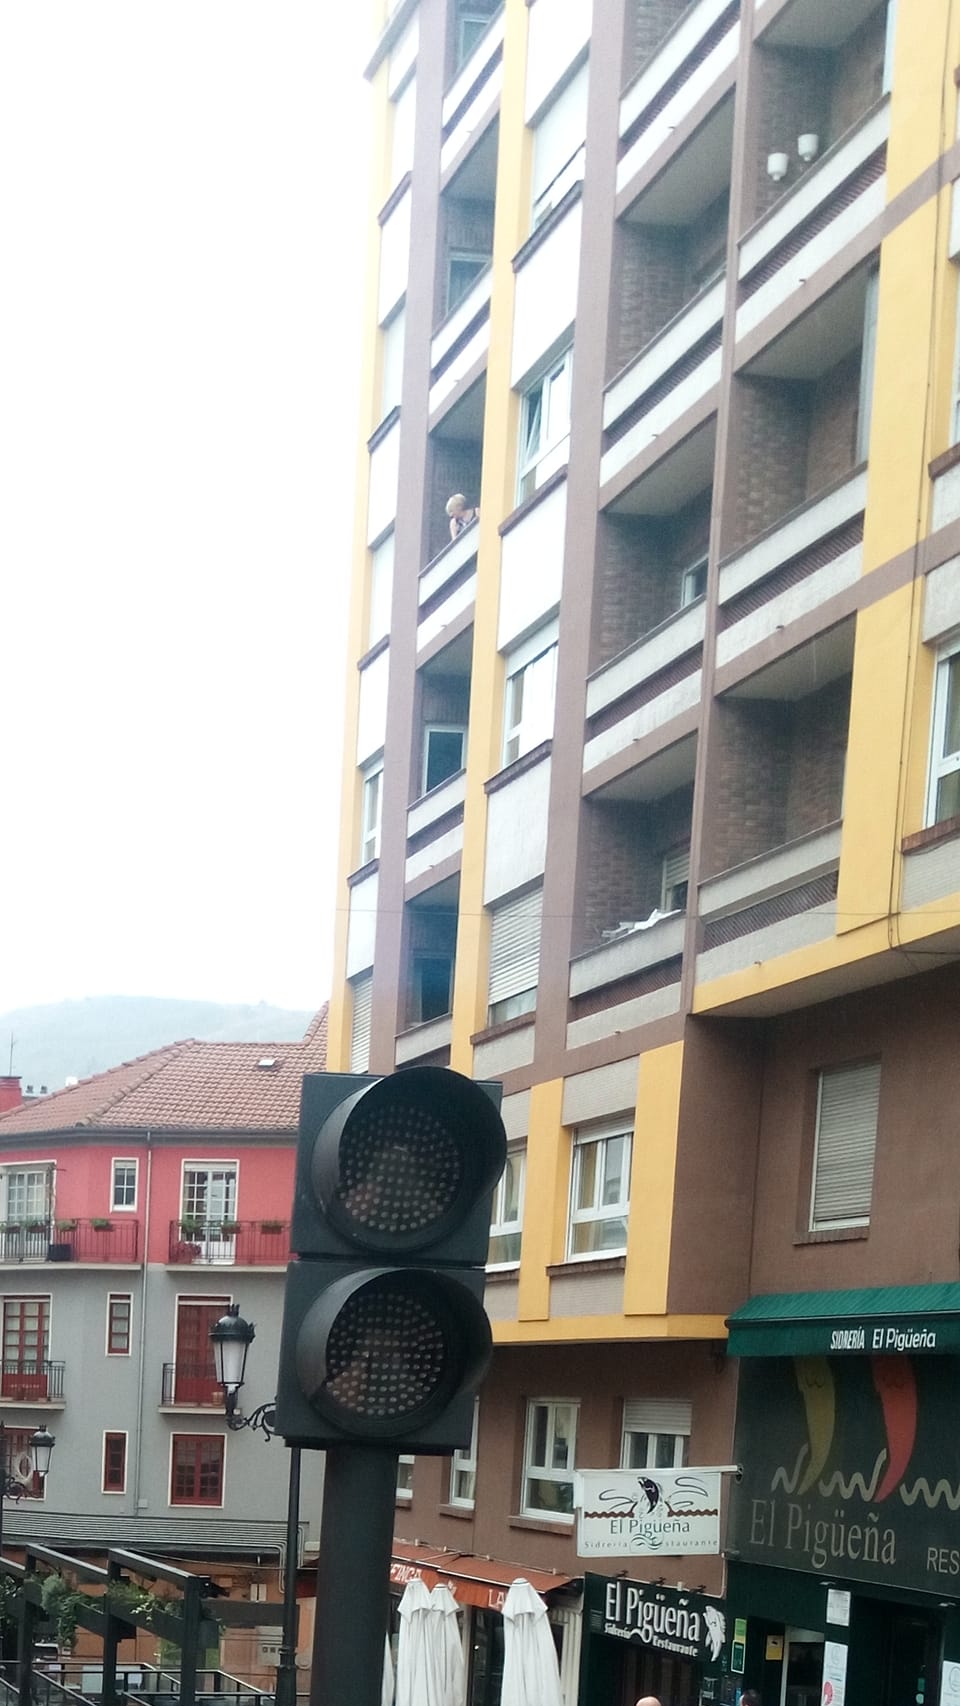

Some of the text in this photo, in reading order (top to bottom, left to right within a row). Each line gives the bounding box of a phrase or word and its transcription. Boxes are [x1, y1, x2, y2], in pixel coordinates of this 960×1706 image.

[872, 1328, 884, 1349] El
[885, 1327, 936, 1351] Pigüeña
[610, 1519, 623, 1534] El
[749, 1499, 897, 1569] El Pigüeña
[926, 1546, 960, 1576] RES
[488, 1588, 506, 1609] LA
[605, 1581, 700, 1643] El Pigüeña
